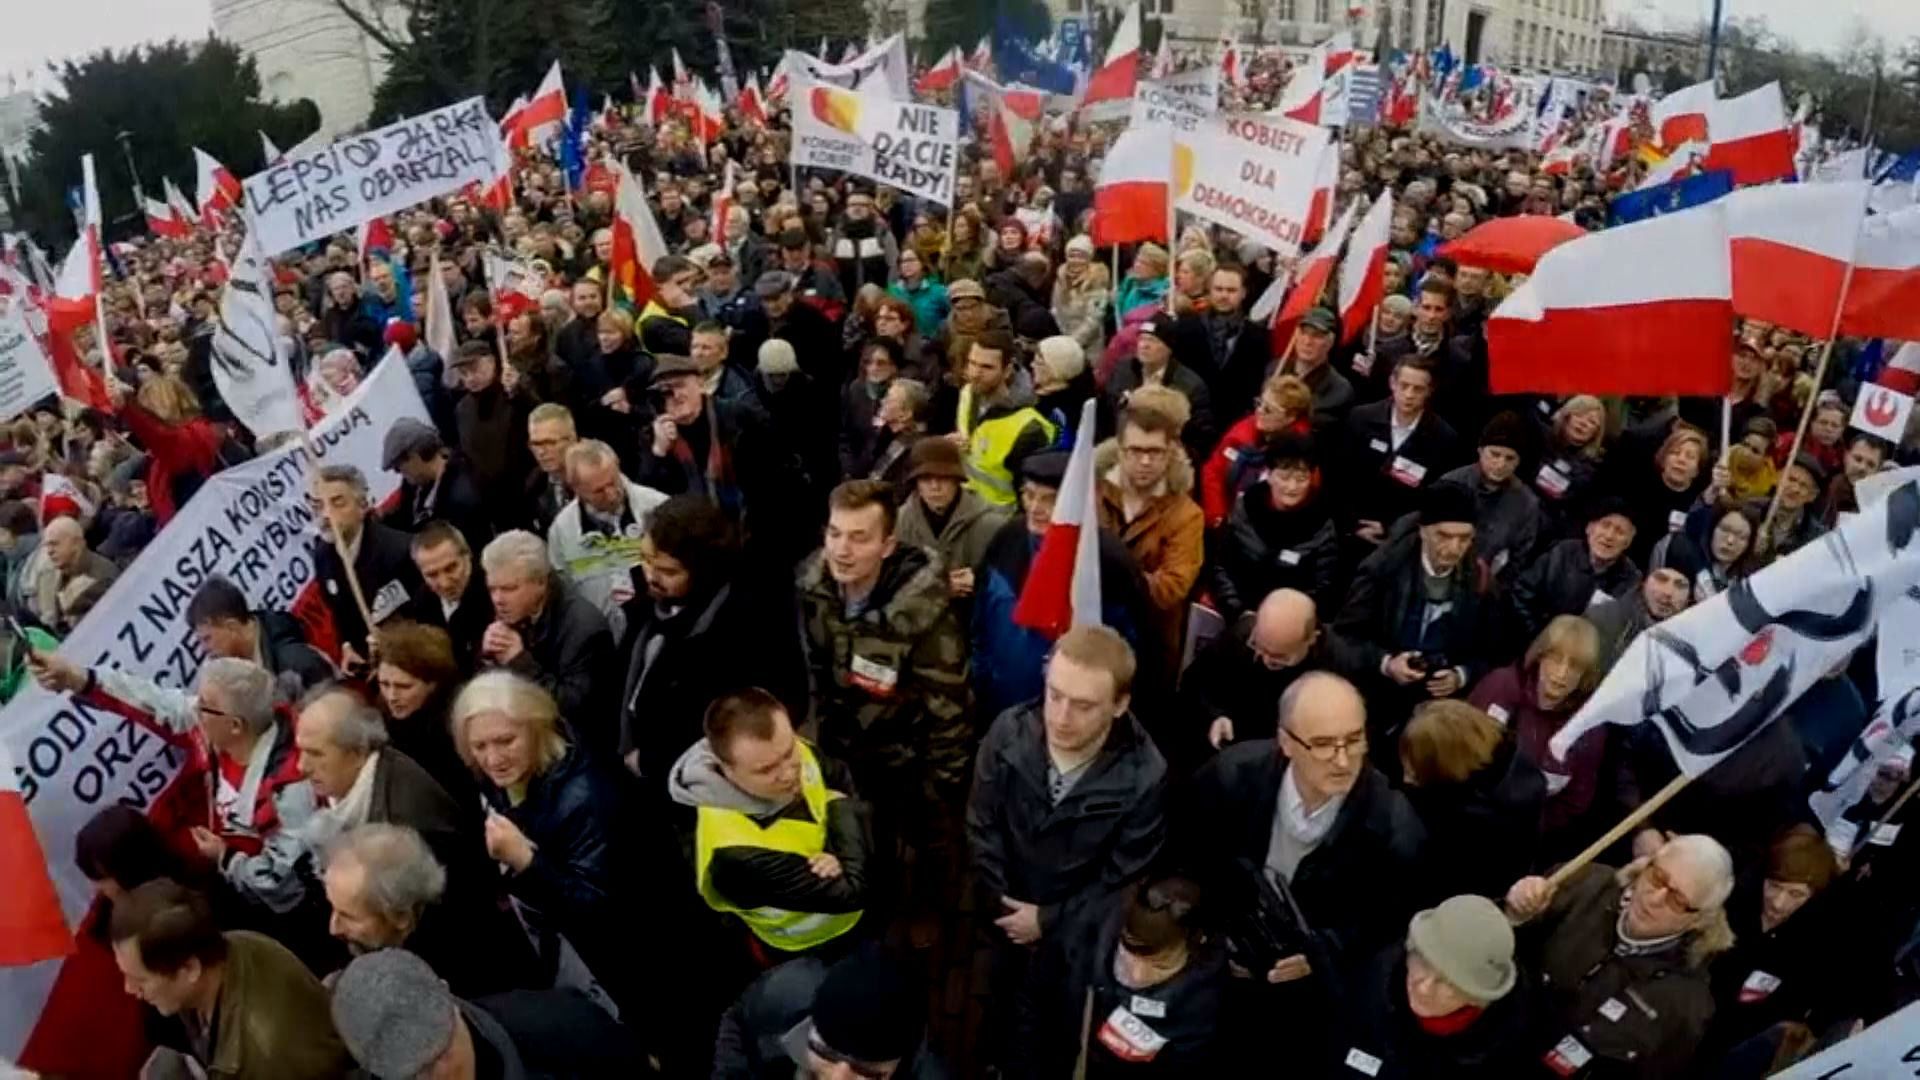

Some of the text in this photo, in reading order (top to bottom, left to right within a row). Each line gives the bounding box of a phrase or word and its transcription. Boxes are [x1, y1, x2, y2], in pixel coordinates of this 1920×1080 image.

[898, 106, 939, 136] NIE
[872, 131, 953, 168] DACIE
[873, 153, 951, 199] RADY!
[1239, 159, 1278, 190] DLA
[294, 184, 351, 238] NAS
[117, 620, 155, 663] Z
